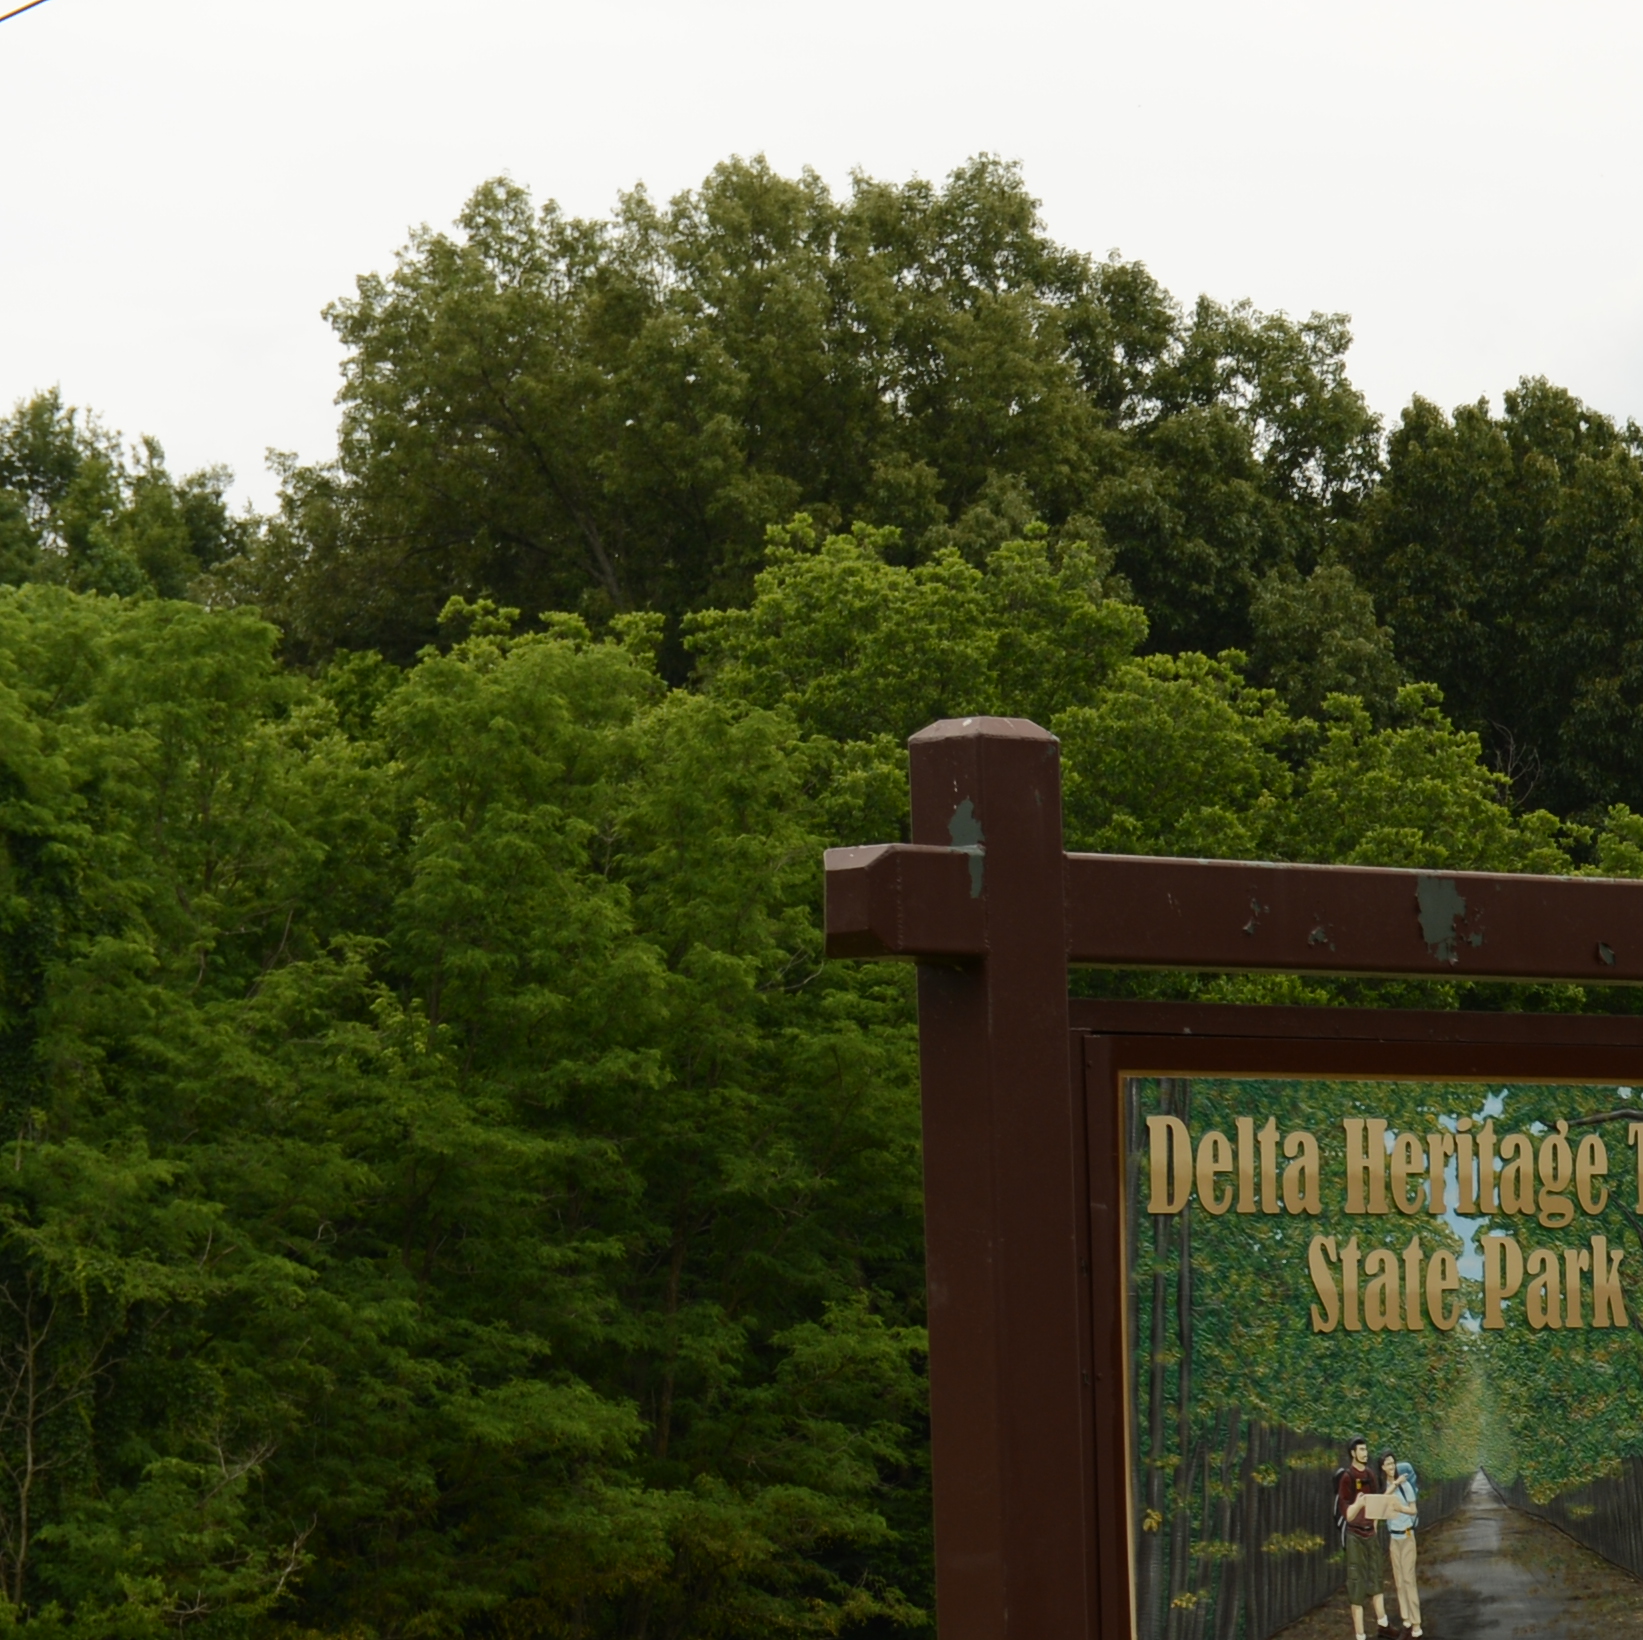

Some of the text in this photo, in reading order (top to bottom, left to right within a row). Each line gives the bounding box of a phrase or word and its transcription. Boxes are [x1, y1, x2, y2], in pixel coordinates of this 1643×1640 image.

[1146, 1115, 1322, 1215] Delta
[1343, 1116, 1609, 1229] Heritage
[1308, 1234, 1628, 1334] State Park
